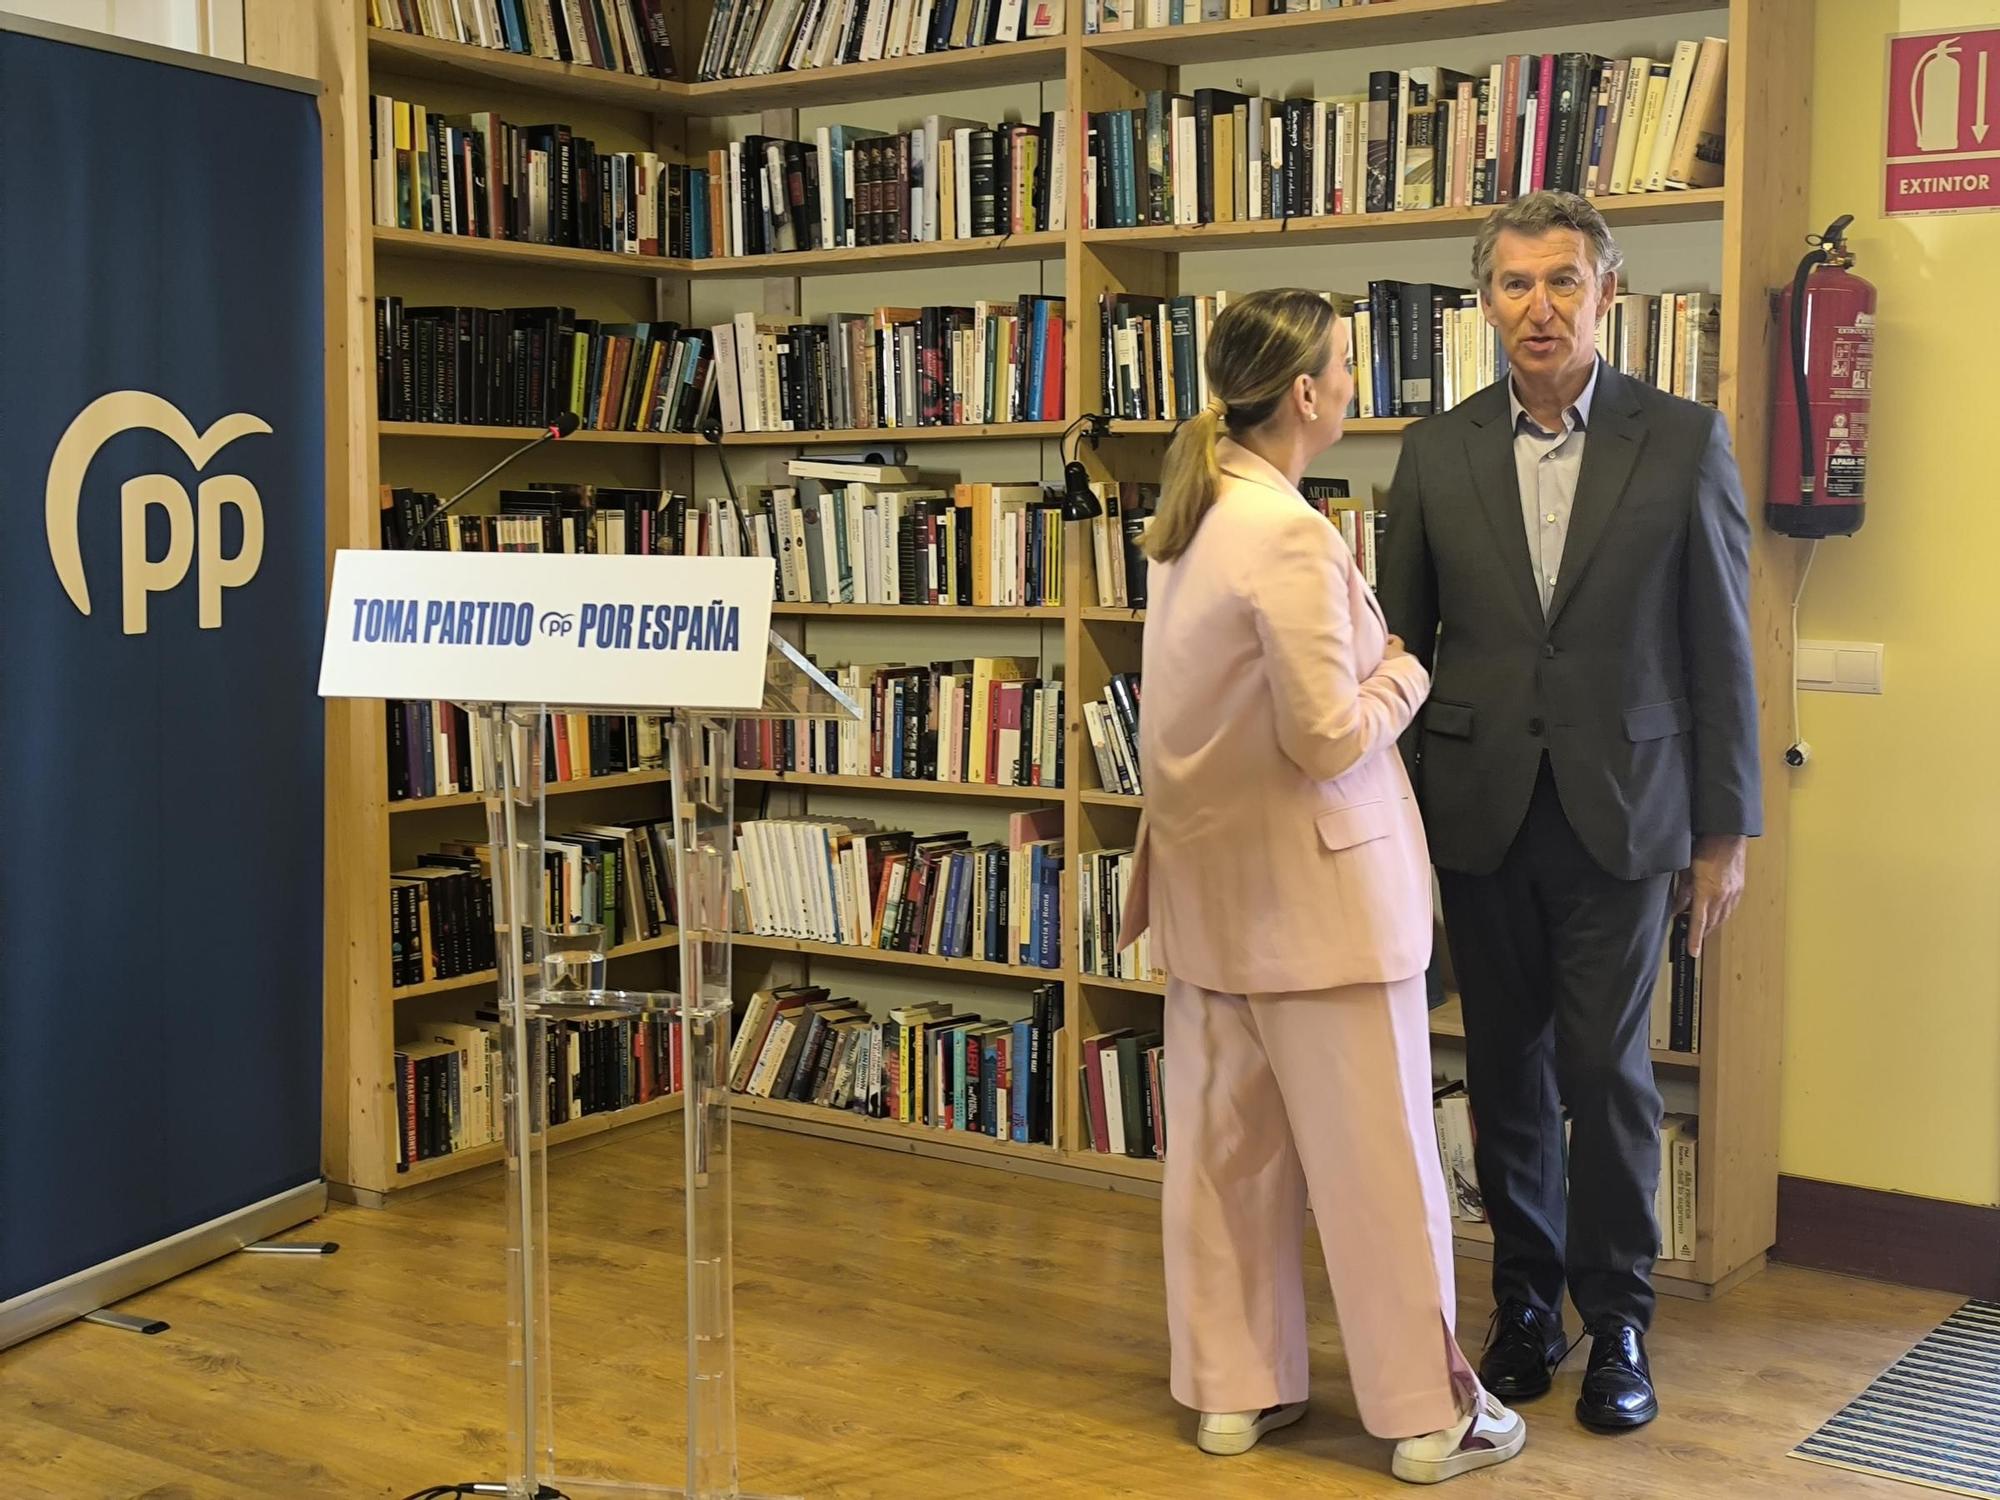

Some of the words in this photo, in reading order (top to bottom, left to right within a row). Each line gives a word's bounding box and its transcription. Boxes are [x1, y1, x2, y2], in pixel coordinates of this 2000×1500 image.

[561, 145, 570, 185] CRICHTON
[1899, 174, 1990, 195] EXTINTOR
[352, 598, 420, 645] TOMA
[423, 600, 534, 648] PARTIDO
[578, 602, 634, 649] POR
[638, 599, 740, 651] ESPAÑA
[1041, 893, 1050, 917] Roma
[1041, 924, 1050, 954] Grecia
[967, 1038, 980, 1077] ALERT
